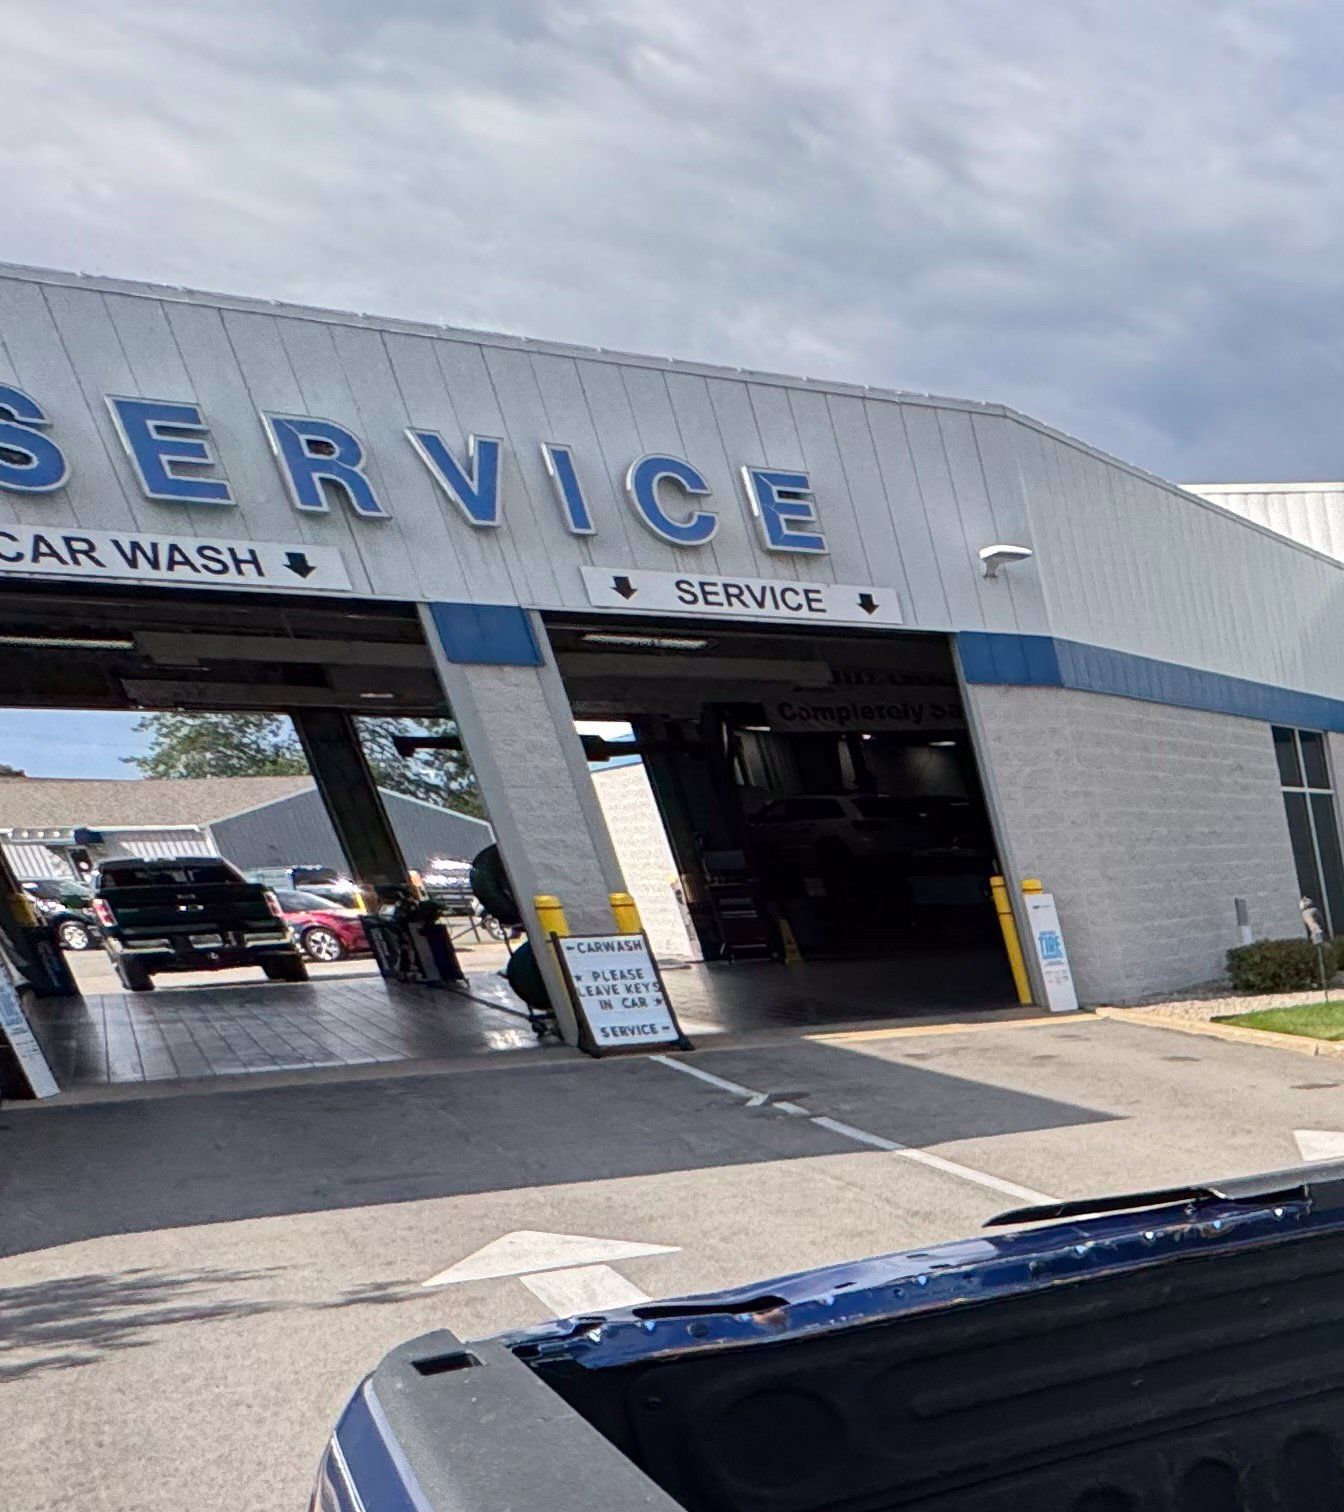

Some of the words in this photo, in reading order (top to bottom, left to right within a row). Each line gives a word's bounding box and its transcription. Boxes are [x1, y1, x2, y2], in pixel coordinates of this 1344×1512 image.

[0, 381, 830, 555] SERVICE
[111, 538, 265, 578] WASH
[674, 579, 828, 614] SERVICE
[778, 702, 924, 725] Completely
[577, 940, 643, 954] CARWASH
[591, 968, 644, 982] PLEASE
[578, 983, 620, 998] LEAVE
[624, 981, 660, 994] KEYS
[599, 1000, 613, 1010] IN
[621, 997, 648, 1009] CAR
[600, 1023, 659, 1038] SERVICE
